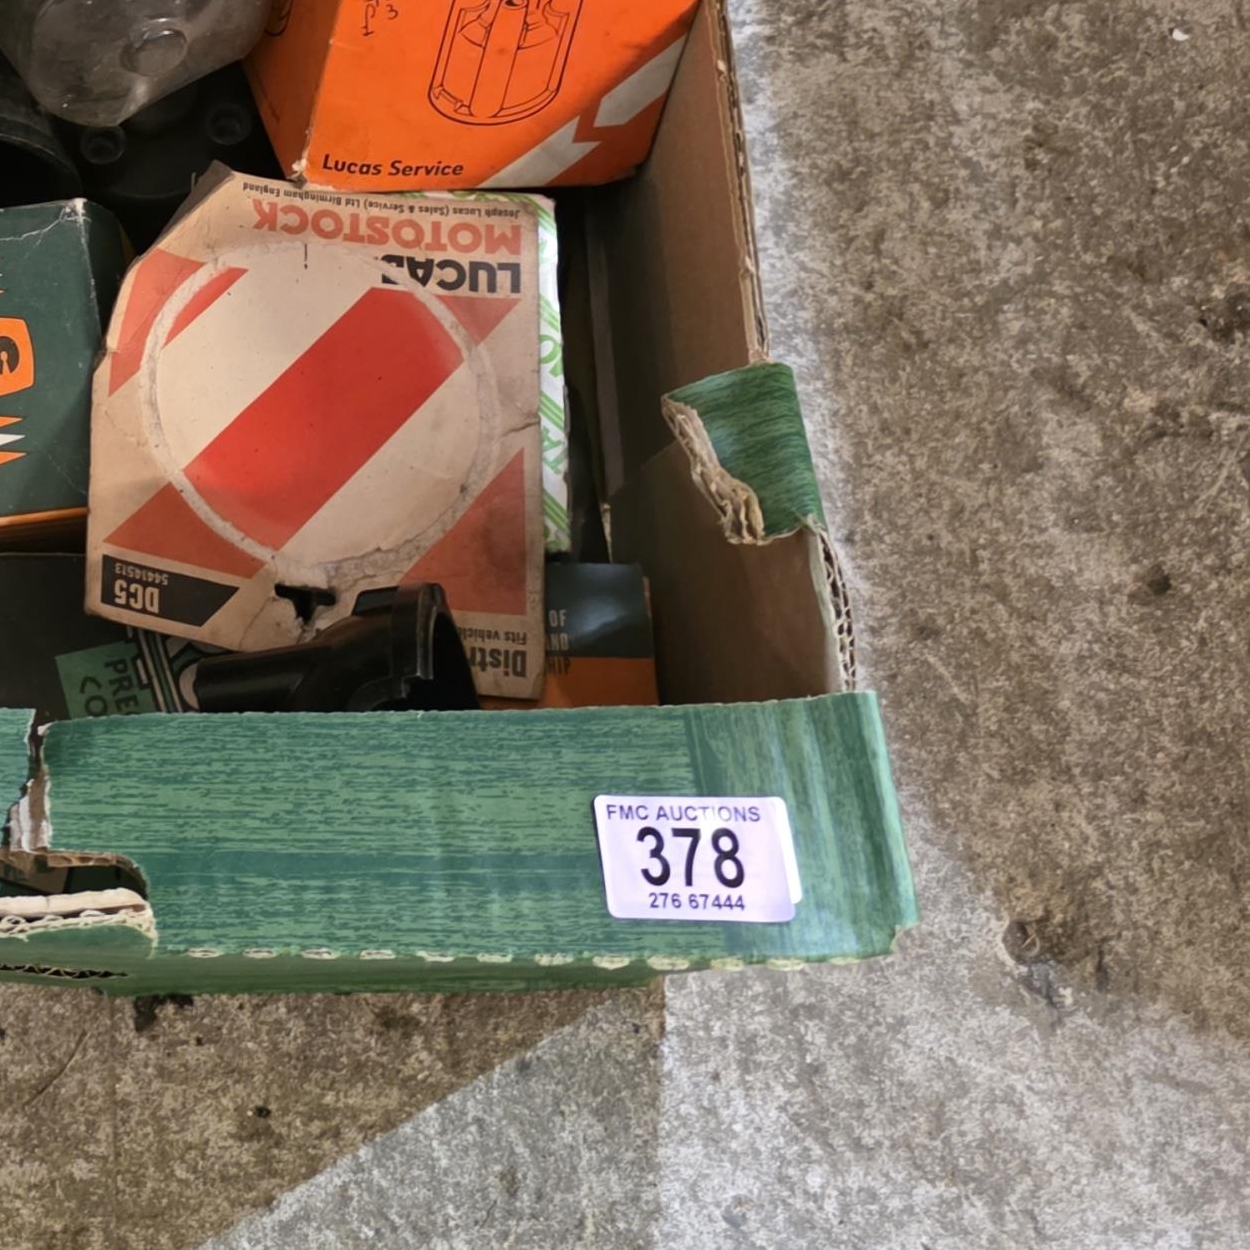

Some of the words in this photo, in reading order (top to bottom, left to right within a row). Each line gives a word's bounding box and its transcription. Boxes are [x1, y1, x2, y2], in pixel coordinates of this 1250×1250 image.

[321, 153, 383, 177] Lucas
[387, 159, 464, 178] Service
[242, 181, 280, 198] England
[283, 188, 342, 207] Birmingham
[343, 197, 362, 209] Ltd
[364, 199, 406, 214] Service)
[418, 204, 450, 218] (Sales
[452, 206, 481, 218] Lucas
[484, 208, 521, 220] Joseph
[252, 197, 522, 256] MOTOSTOCK
[114, 579, 160, 613] DC5
[504, 631, 527, 645] Fits
[104, 657, 140, 716] PRE
[606, 804, 649, 820] FMC
[656, 805, 761, 822] AUCTIONS
[636, 826, 745, 888] 378
[649, 892, 682, 909] 276
[688, 893, 746, 911] 67444
